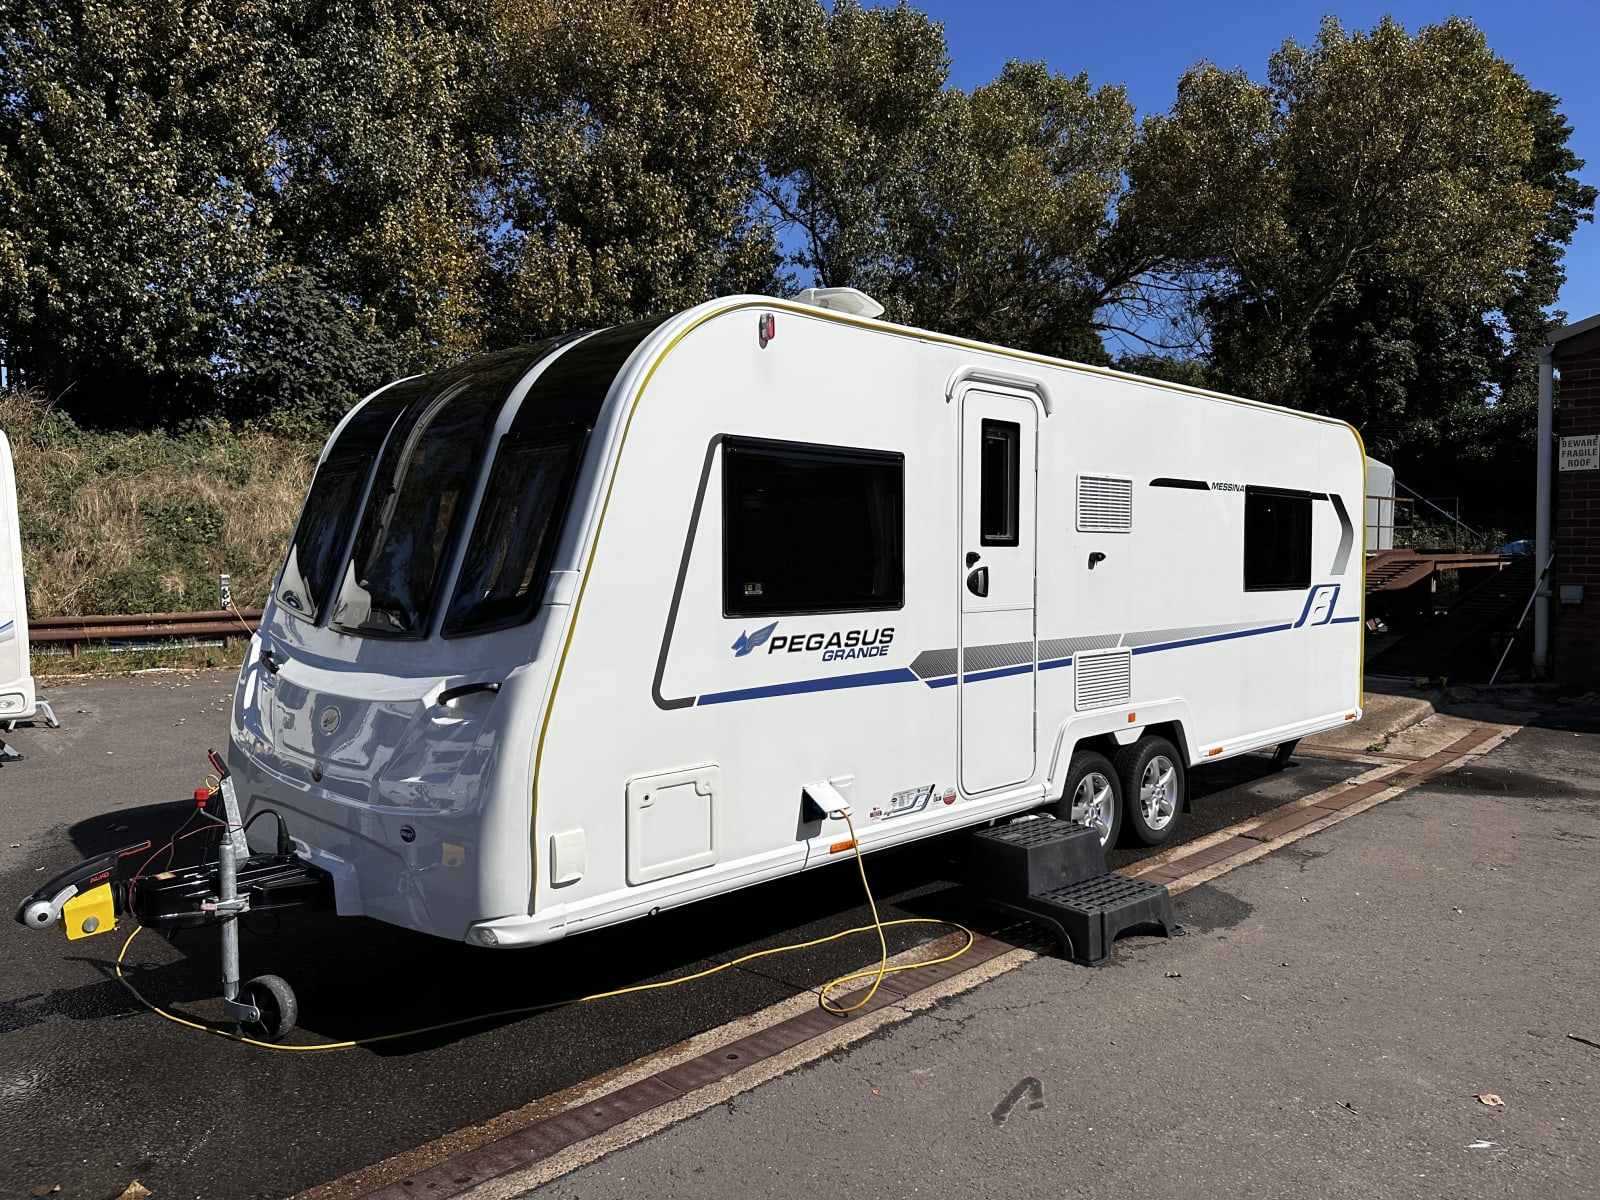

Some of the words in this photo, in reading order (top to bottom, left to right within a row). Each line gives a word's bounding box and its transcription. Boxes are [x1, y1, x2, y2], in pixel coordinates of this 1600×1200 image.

[1561, 438, 1598, 448] BEWARE
[1561, 448, 1598, 458] FRAGILE
[1567, 458, 1592, 467] ROOF
[1211, 481, 1245, 492] MESSINA
[767, 627, 895, 654] PEGASUS
[822, 645, 890, 662] GRANDE
